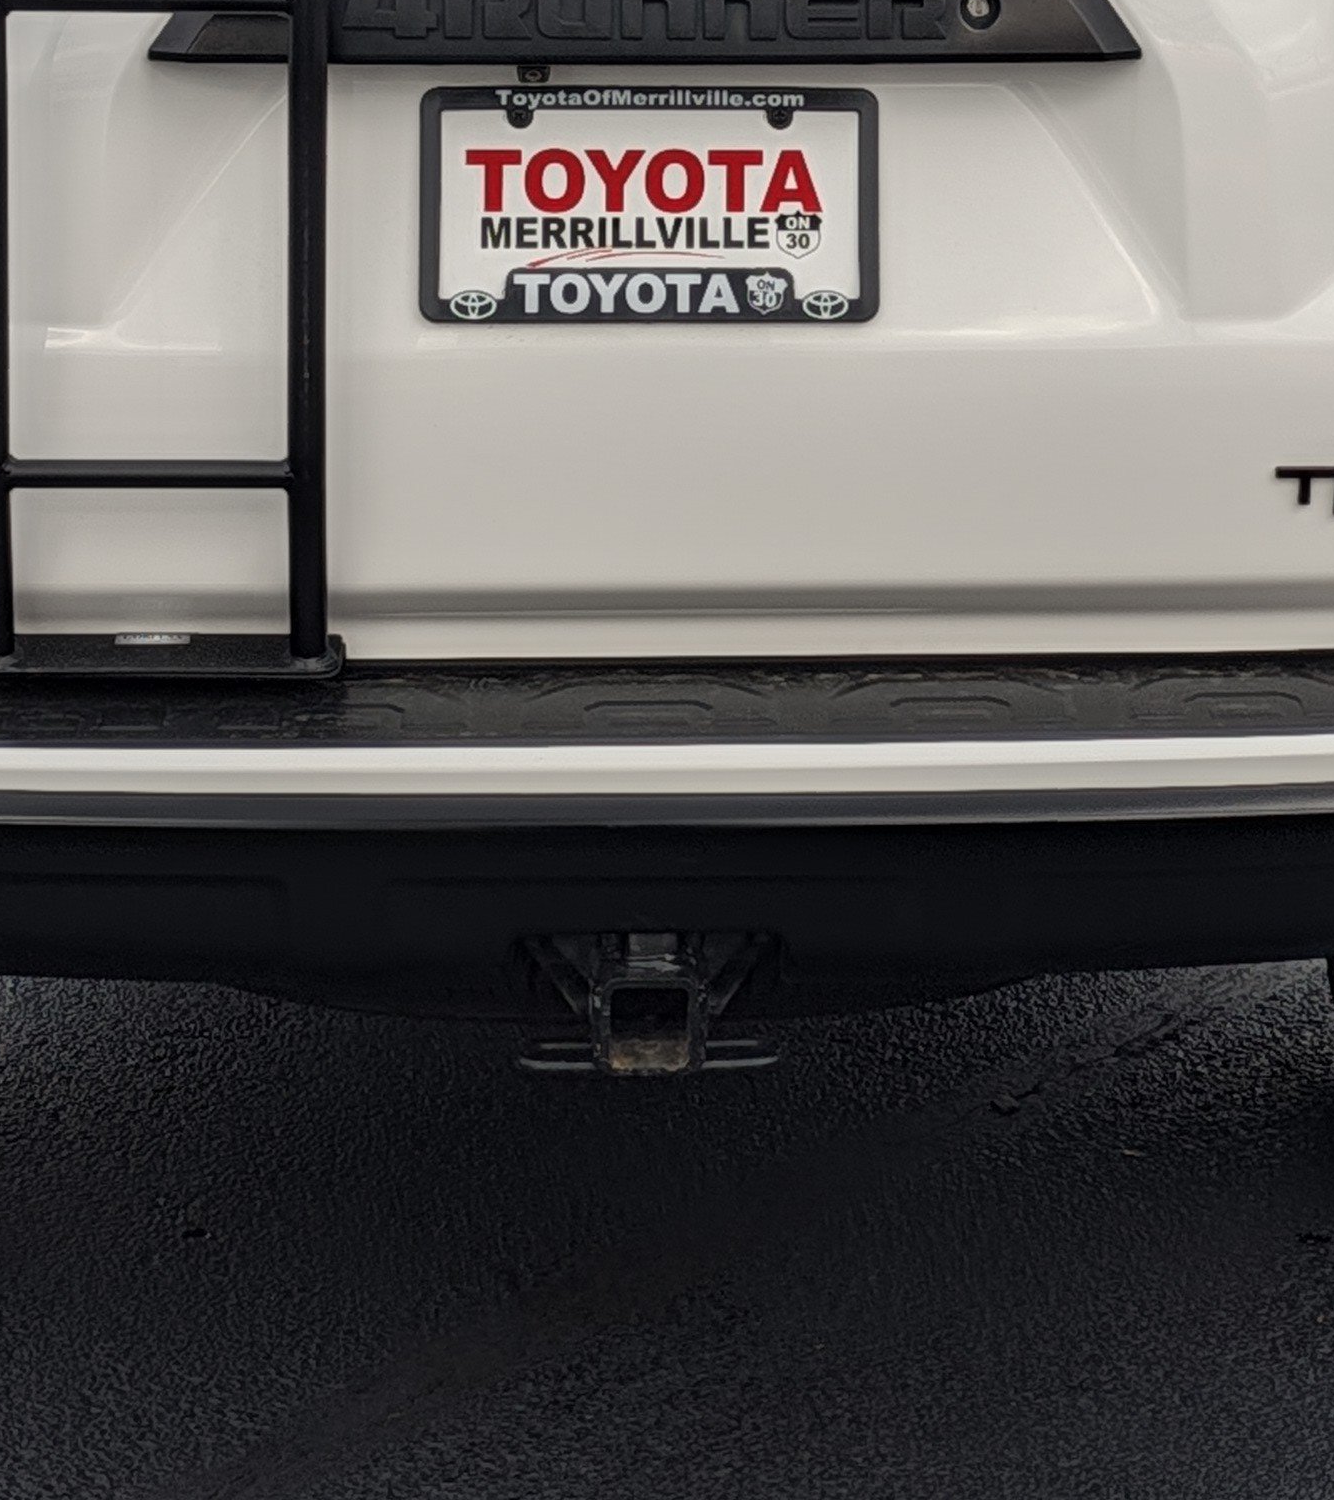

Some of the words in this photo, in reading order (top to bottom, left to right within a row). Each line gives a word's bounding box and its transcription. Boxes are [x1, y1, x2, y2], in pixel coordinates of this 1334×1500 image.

[495, 89, 805, 109] ToyotaOfMerrillville.com
[465, 148, 823, 213] TOYOTA
[784, 215, 811, 230] ON
[480, 217, 771, 249] MERRILLVILLE
[785, 233, 810, 249] 30
[513, 273, 740, 314] TOYOTA
[757, 279, 775, 291] ON
[752, 290, 777, 308] 30
